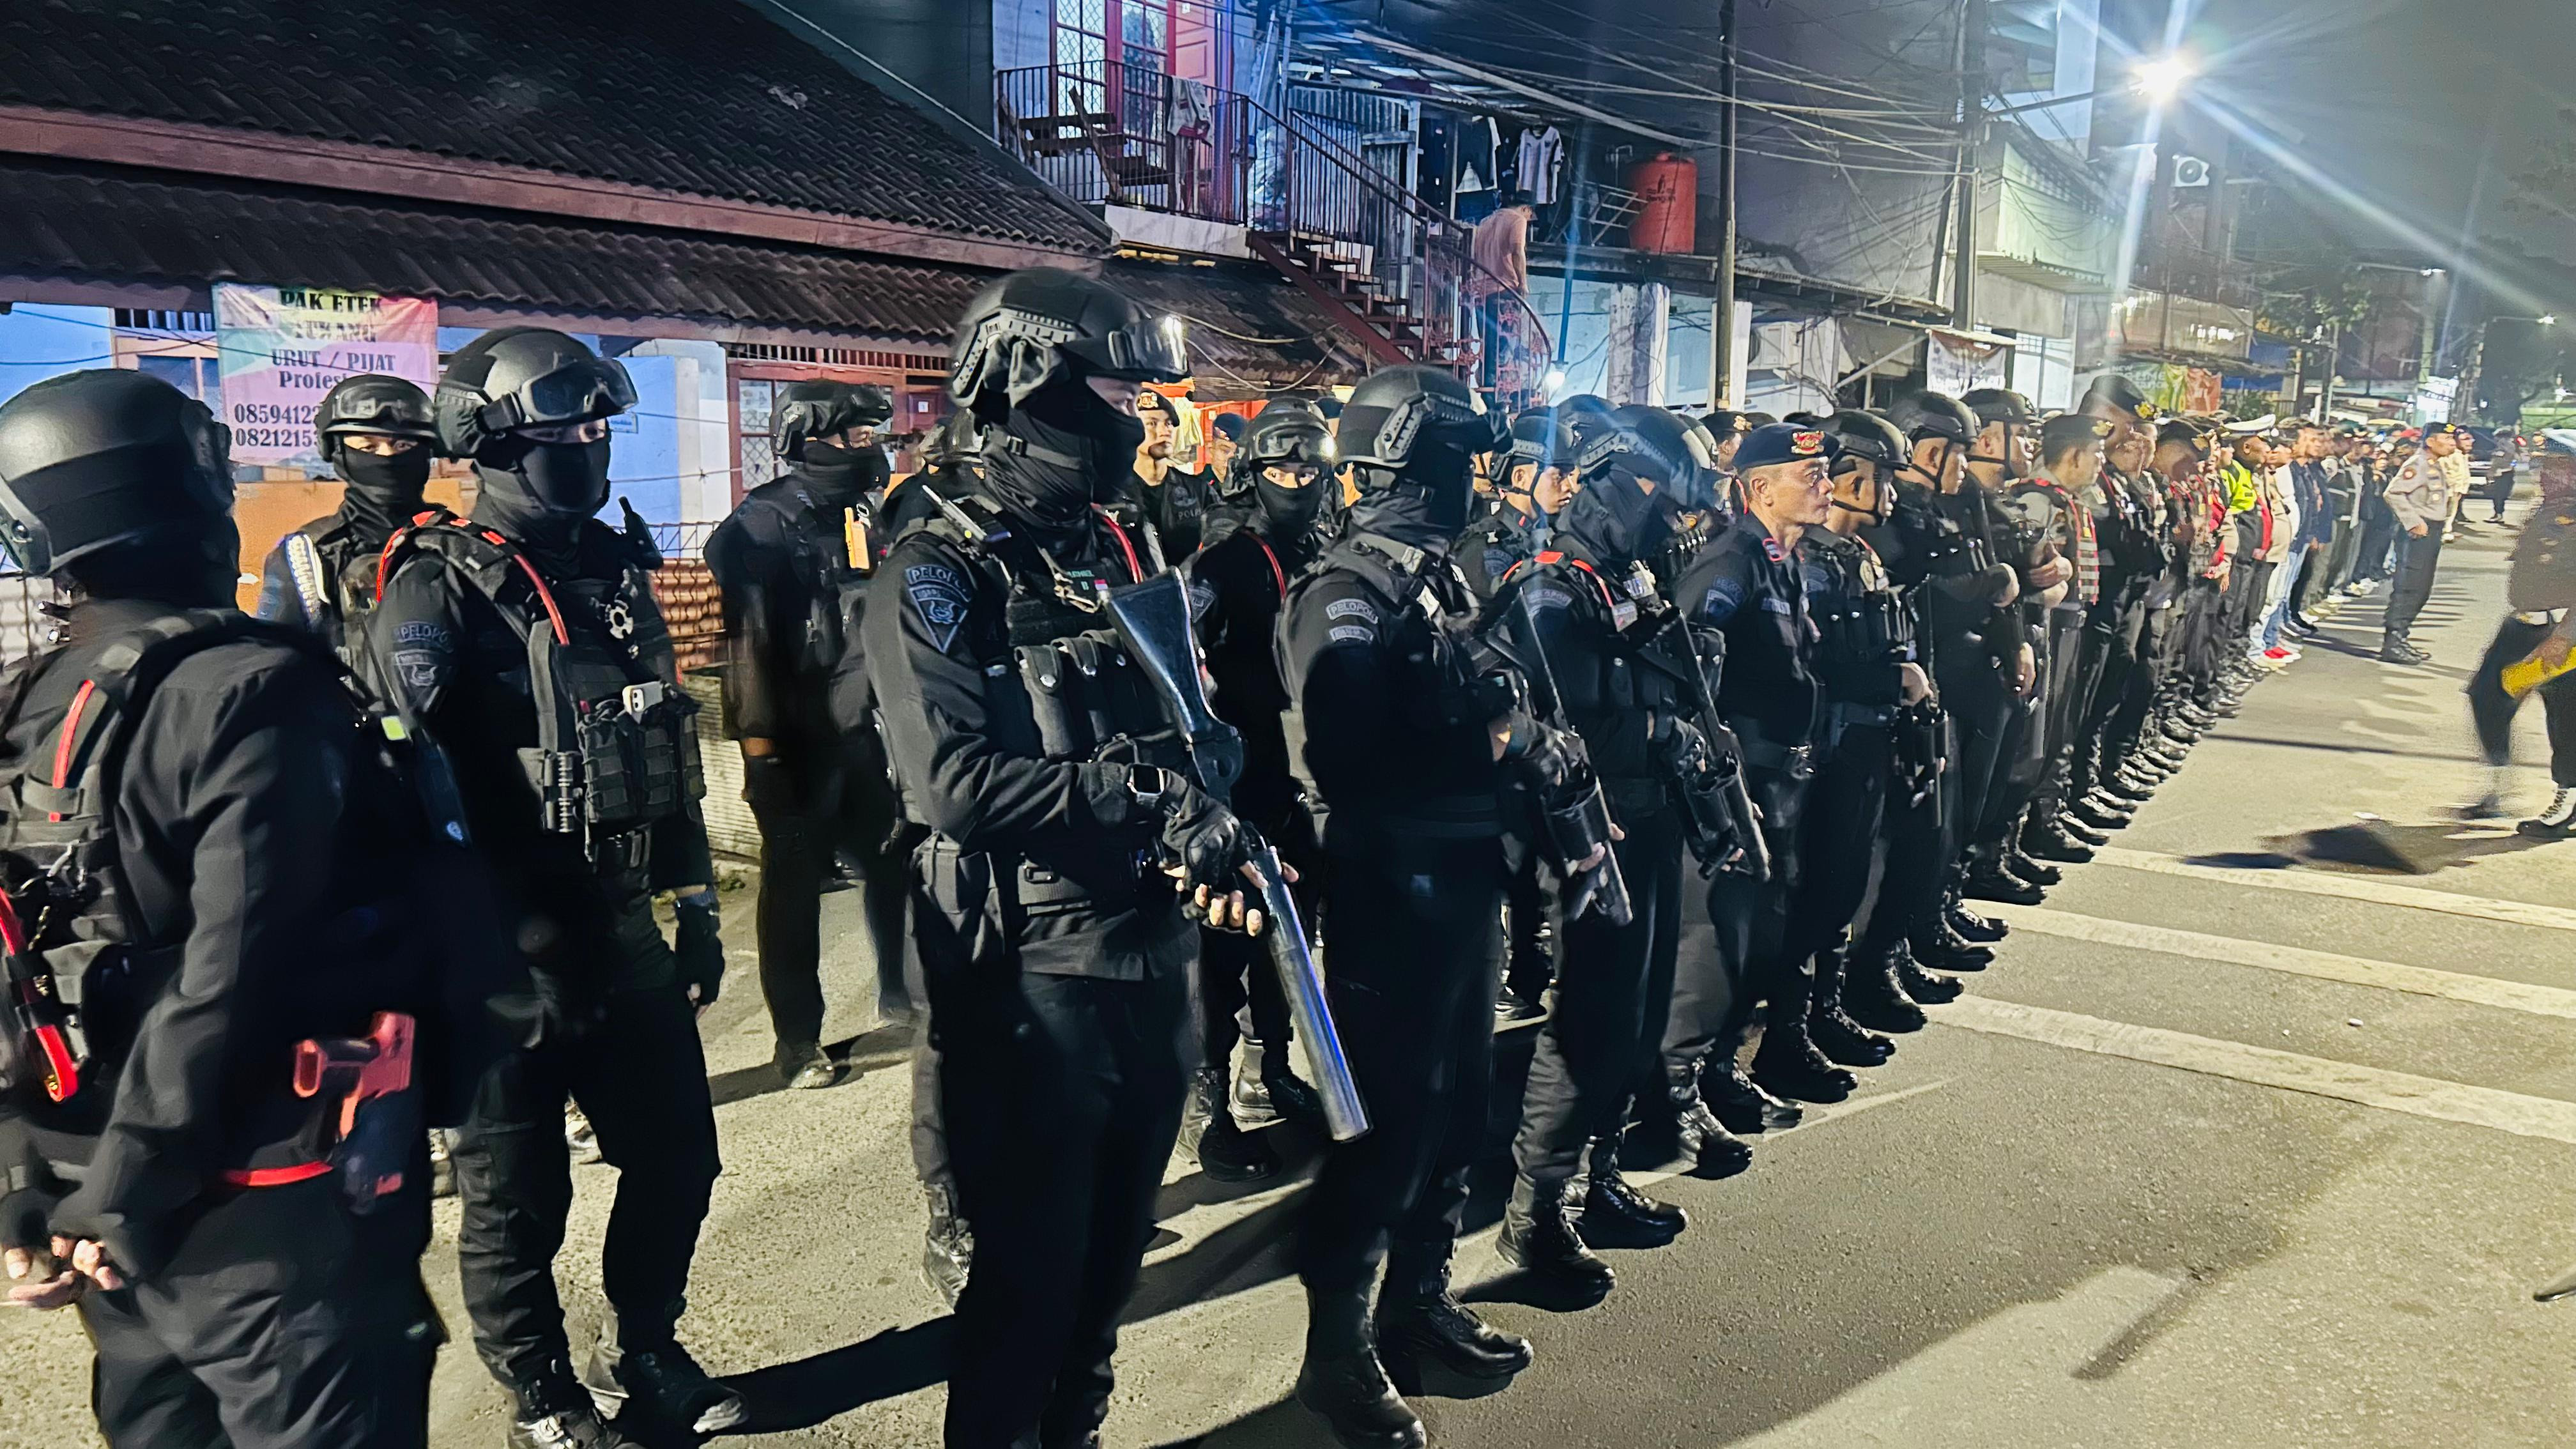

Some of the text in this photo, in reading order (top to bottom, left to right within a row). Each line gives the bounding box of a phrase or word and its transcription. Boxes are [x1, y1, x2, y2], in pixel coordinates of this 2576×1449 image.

[280, 290, 323, 310] PAK
[272, 348, 396, 371] URUT / PIJAT
